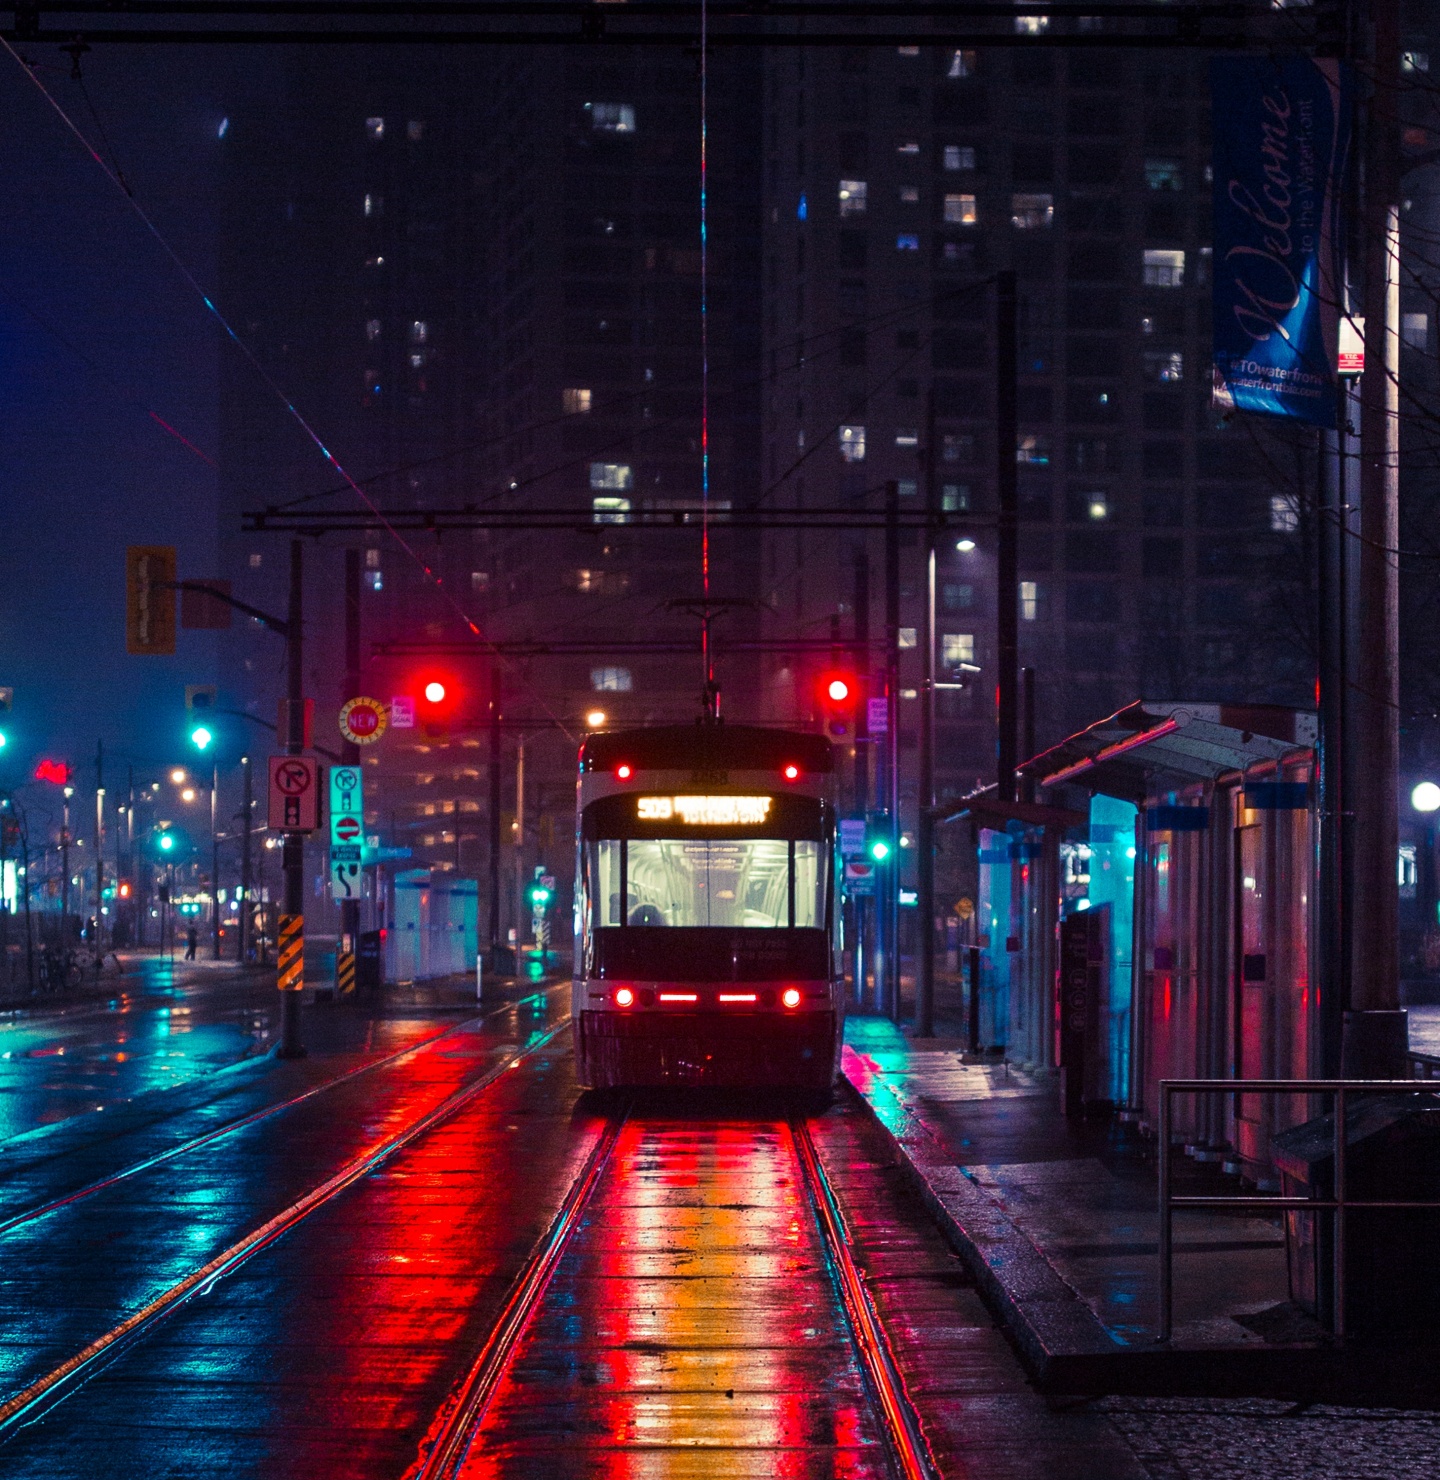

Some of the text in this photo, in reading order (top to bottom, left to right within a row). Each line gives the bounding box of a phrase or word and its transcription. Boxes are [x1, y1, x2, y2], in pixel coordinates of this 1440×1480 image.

[1225, 88, 1299, 341] Welcome
[1298, 200, 1314, 228] the
[1300, 235, 1314, 253] to
[349, 713, 377, 727] NEW
[638, 797, 672, 819] 509
